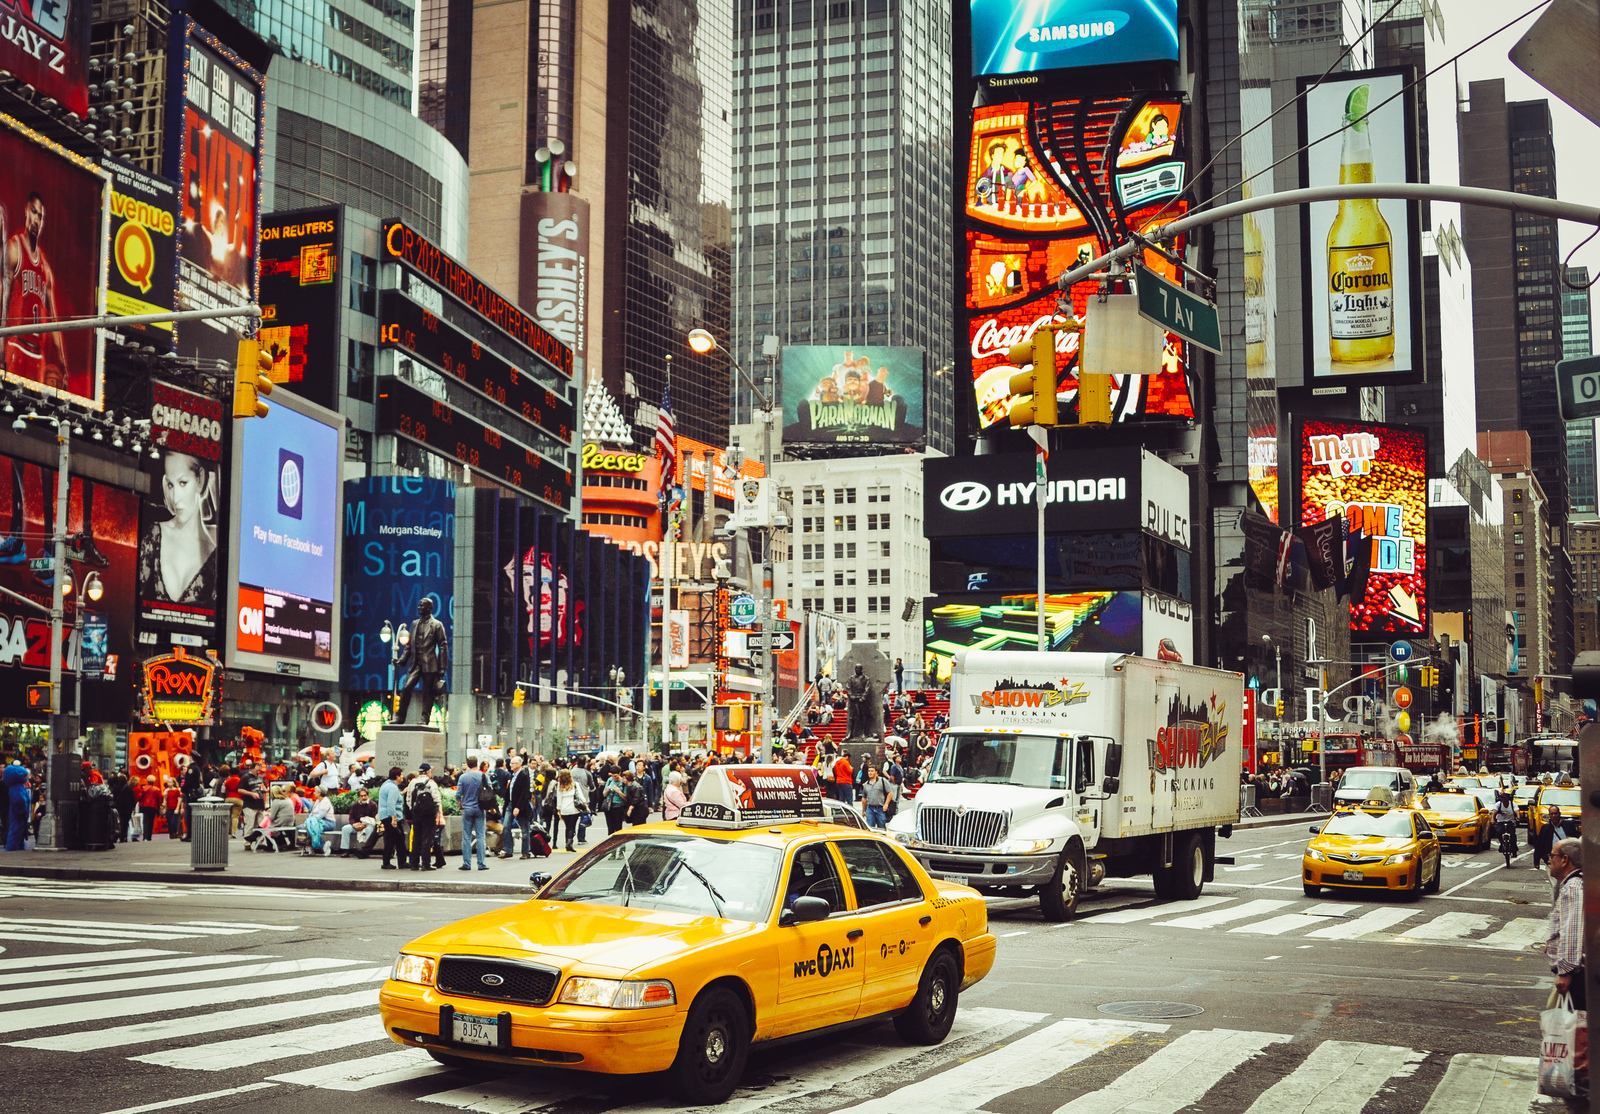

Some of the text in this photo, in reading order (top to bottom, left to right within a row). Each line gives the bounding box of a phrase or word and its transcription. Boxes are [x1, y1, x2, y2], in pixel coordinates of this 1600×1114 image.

[1029, 20, 1115, 43] SAMSUNG
[1, 15, 47, 60] JAY
[48, 44, 65, 74] Z
[989, 76, 1038, 87] SHERWOOD
[117, 173, 158, 196] BEST MUSICAL
[181, 106, 256, 258] EVITA
[282, 220, 335, 239] REUTERS
[114, 222, 155, 293] Q
[1331, 271, 1391, 294] Corona
[415, 236, 441, 284] 2012
[522, 315, 563, 373] FINANCIAL
[1159, 288, 1168, 317] 7
[1344, 294, 1377, 312] Light
[151, 403, 222, 441] CHICAGO
[807, 399, 897, 431] PARANORMAN
[581, 442, 647, 473] Reese's
[253, 525, 323, 558] Play from Facebook too!
[379, 525, 443, 539] Morgan Stanley
[238, 605, 263, 637] CNN
[738, 605, 747, 616] 46
[991, 709, 1068, 718] TRUCKING
[750, 776, 795, 789] WINNING
[694, 804, 719, 819] 8J52
[485, 976, 498, 984] Ford
[793, 961, 817, 978] NYC
